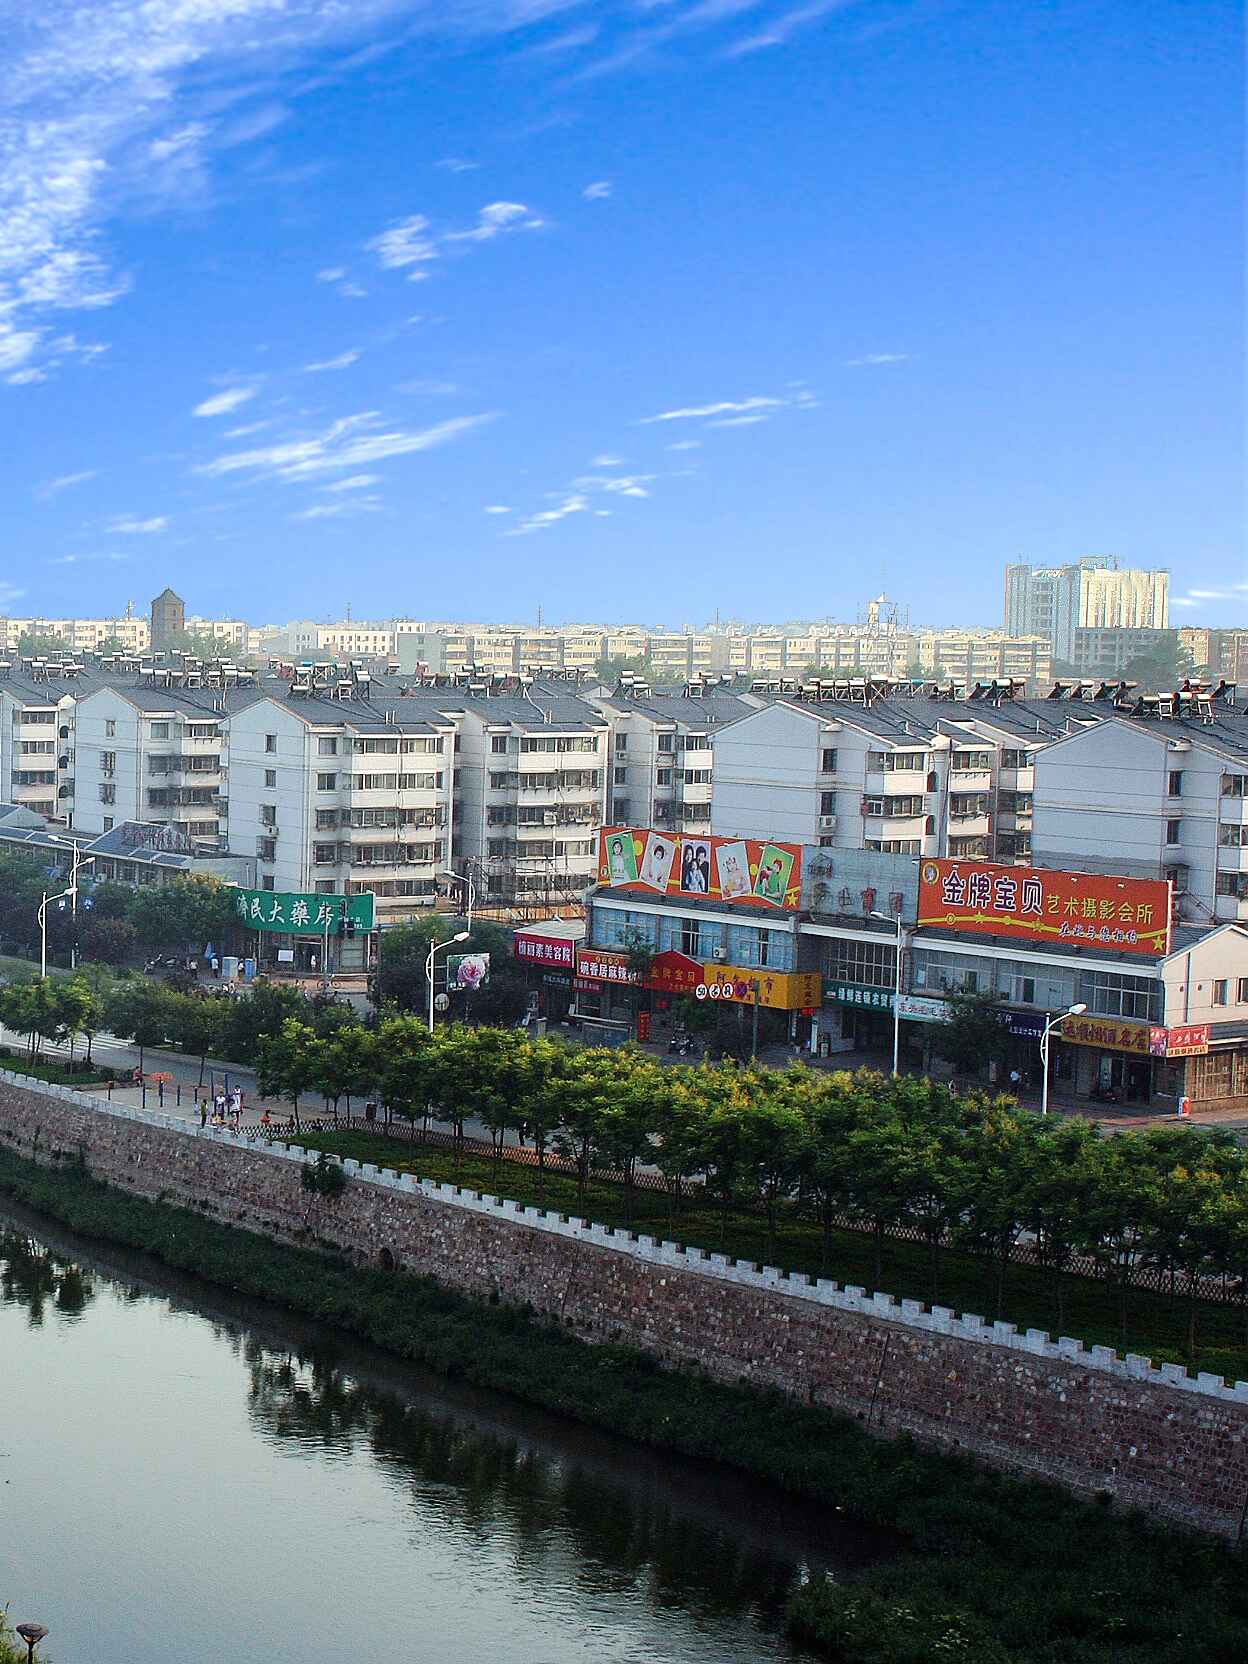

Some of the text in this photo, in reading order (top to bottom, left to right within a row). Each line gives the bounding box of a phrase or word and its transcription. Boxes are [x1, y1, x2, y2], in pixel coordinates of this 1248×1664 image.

[942, 870, 1154, 925] 金牌宝贝 艺术摄影会所
